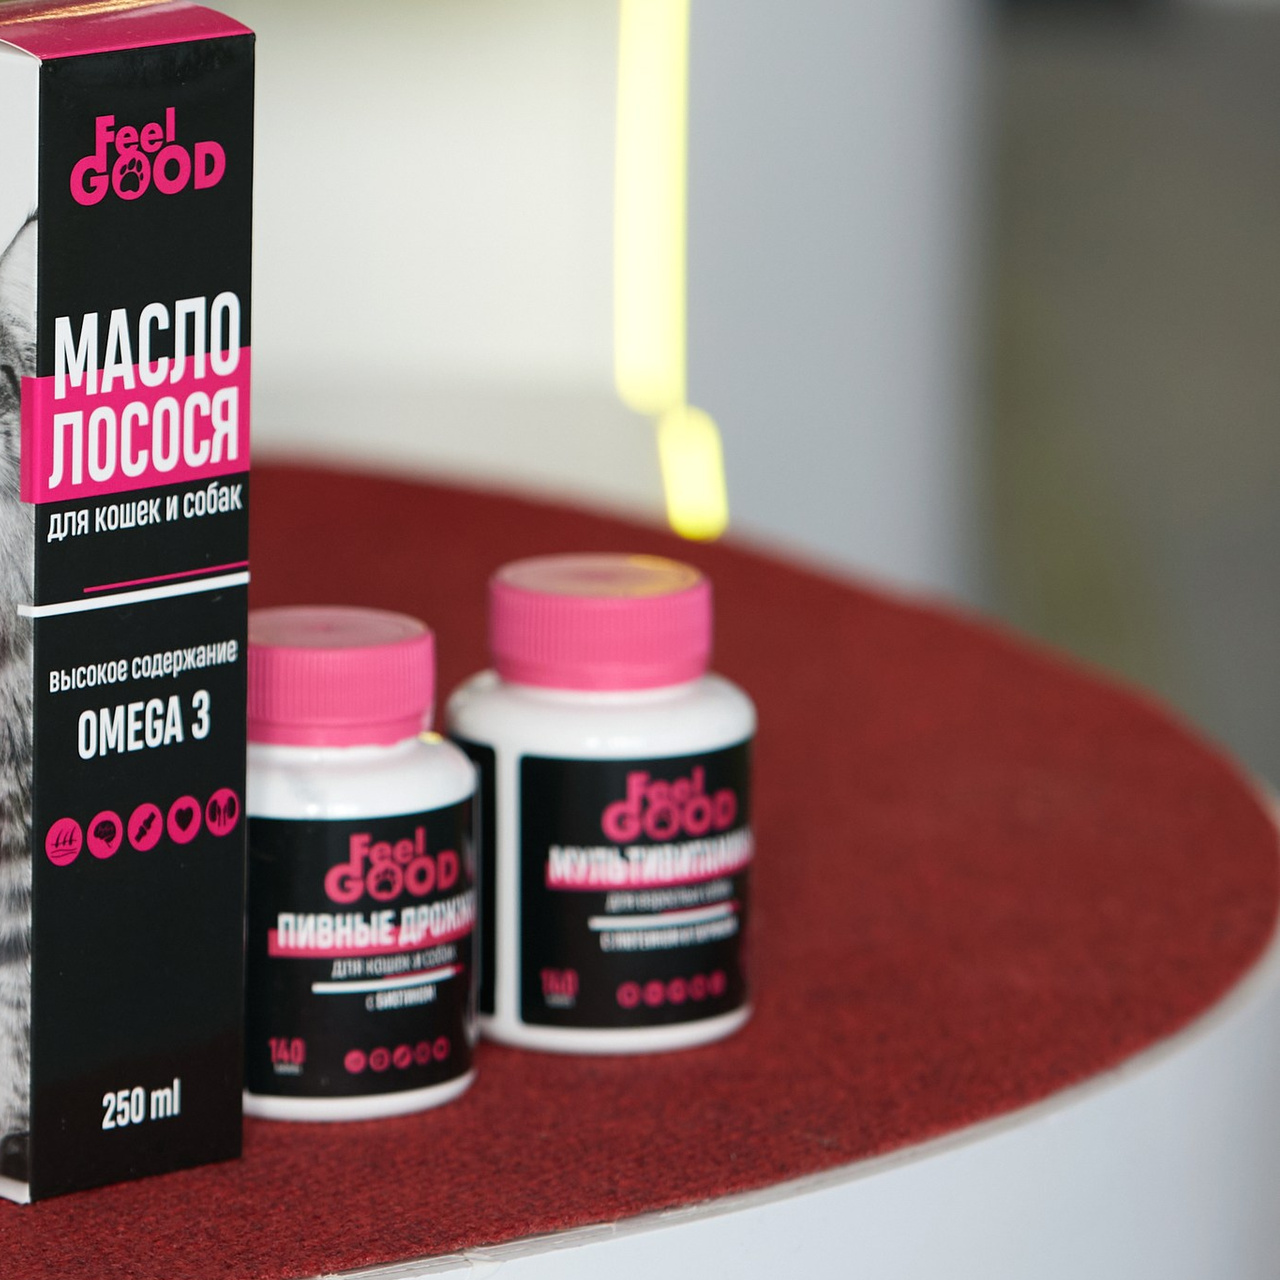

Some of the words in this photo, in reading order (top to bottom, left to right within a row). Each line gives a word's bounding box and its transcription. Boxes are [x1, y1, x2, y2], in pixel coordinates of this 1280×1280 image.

[95, 106, 176, 166] Feel
[69, 139, 227, 207] GOOD
[53, 290, 242, 401] МАСЛО
[47, 385, 240, 490] ЛОСОСЯ
[46, 508, 90, 544] для
[94, 496, 162, 534] кошек
[165, 494, 179, 522] и
[182, 480, 244, 519] собак
[48, 658, 128, 694] высокое
[130, 638, 240, 680] содержание
[76, 694, 185, 761] OMEGA
[190, 688, 212, 740] 3
[324, 849, 460, 905] GOOD
[349, 825, 427, 876] Feel
[277, 910, 397, 950] ПИВНЫЕ
[101, 1085, 145, 1131] 250
[149, 1076, 182, 1119] ml
